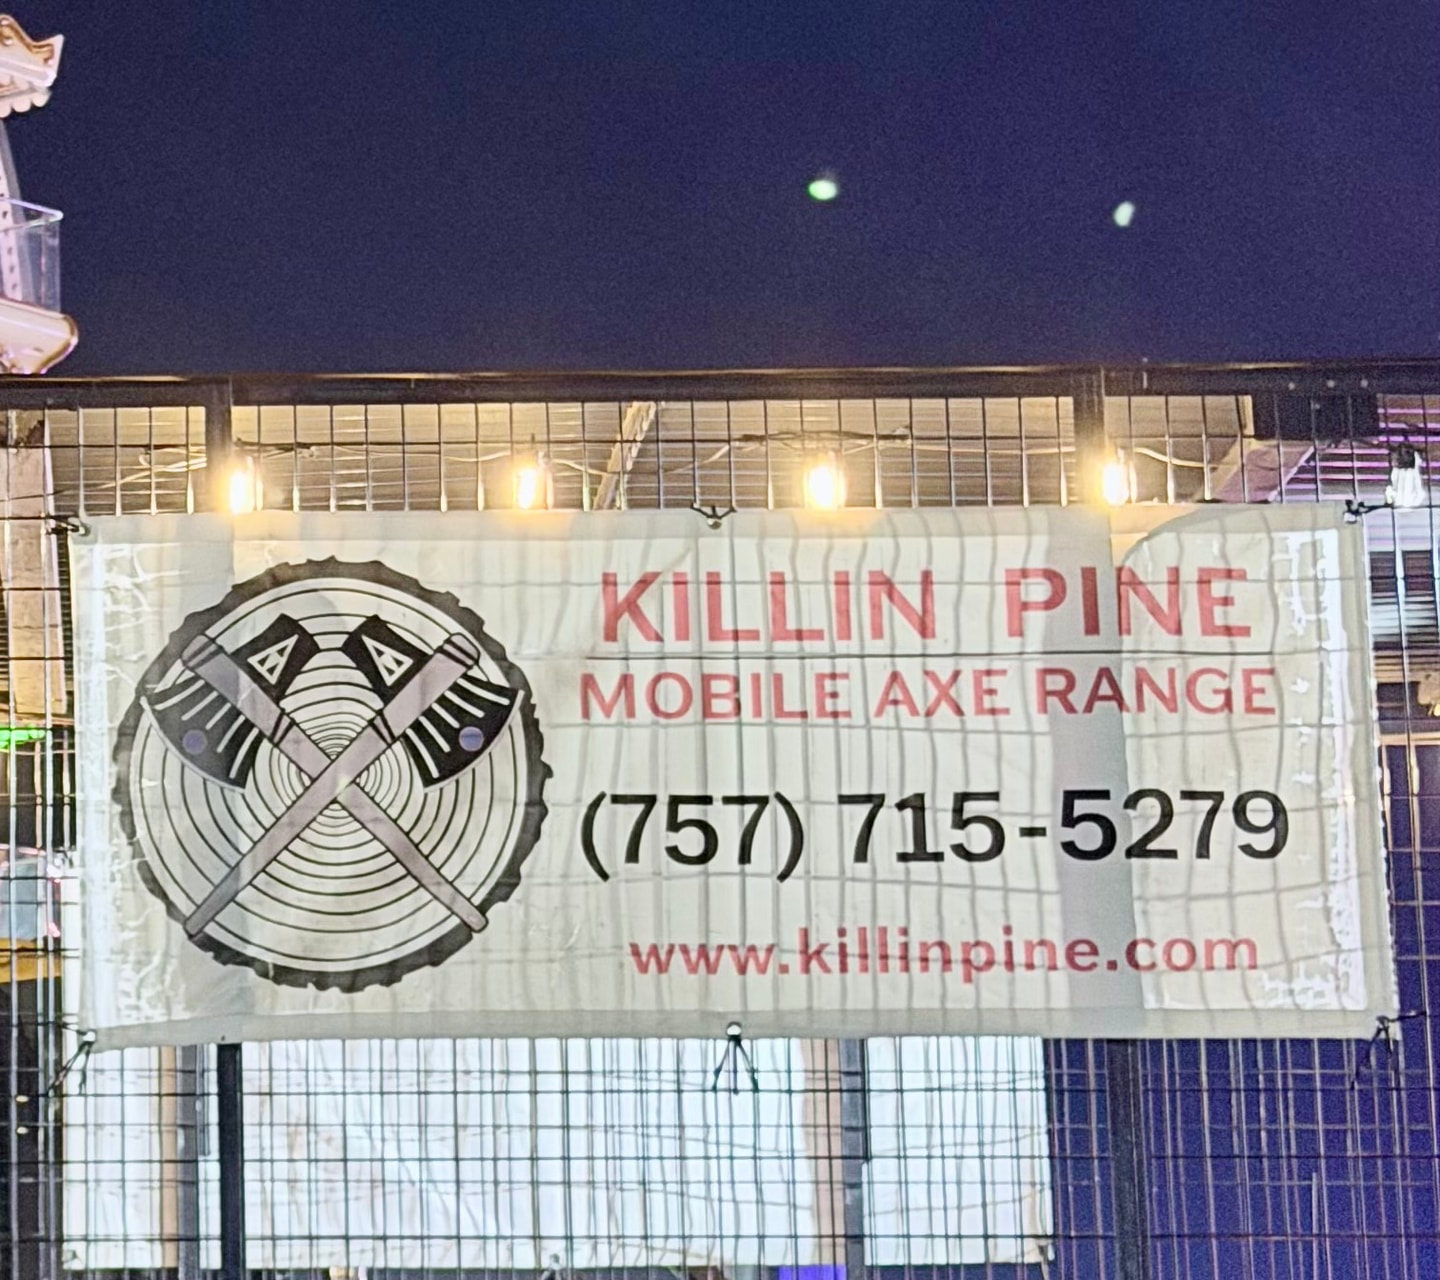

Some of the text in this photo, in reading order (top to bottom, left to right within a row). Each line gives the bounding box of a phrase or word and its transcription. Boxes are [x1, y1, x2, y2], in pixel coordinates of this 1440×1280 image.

[601, 565, 1252, 643] KILLIN PINE
[580, 666, 1277, 720] MOBILE AXE RANGE
[580, 787, 1290, 883] (757) 715-5279
[628, 924, 1259, 984] www.killinpine.com
